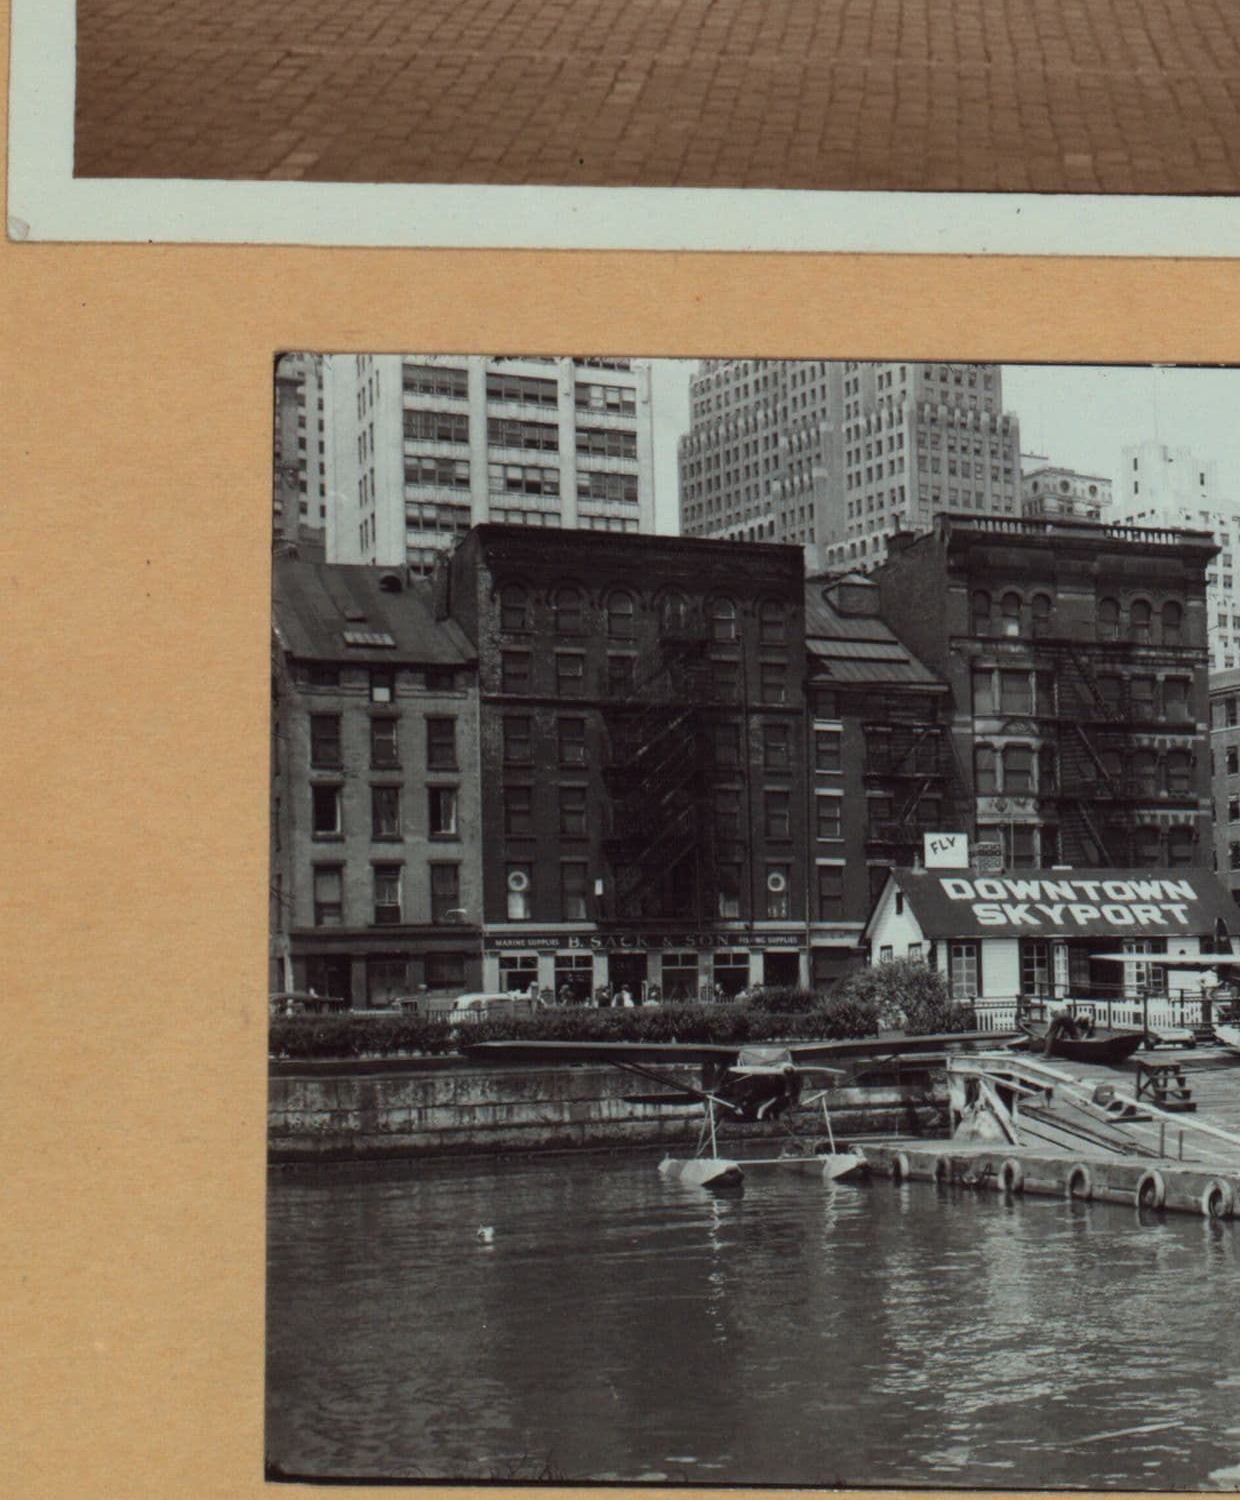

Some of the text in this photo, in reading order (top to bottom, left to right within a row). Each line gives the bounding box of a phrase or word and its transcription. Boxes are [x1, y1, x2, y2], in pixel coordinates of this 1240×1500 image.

[930, 836, 956, 855] FLY
[939, 877, 1199, 901] DOWNTOWN
[970, 902, 1191, 927] SKYPORT
[495, 938, 560, 947] MARINE SUPPLIES
[568, 935, 729, 949] B. SACK & SON
